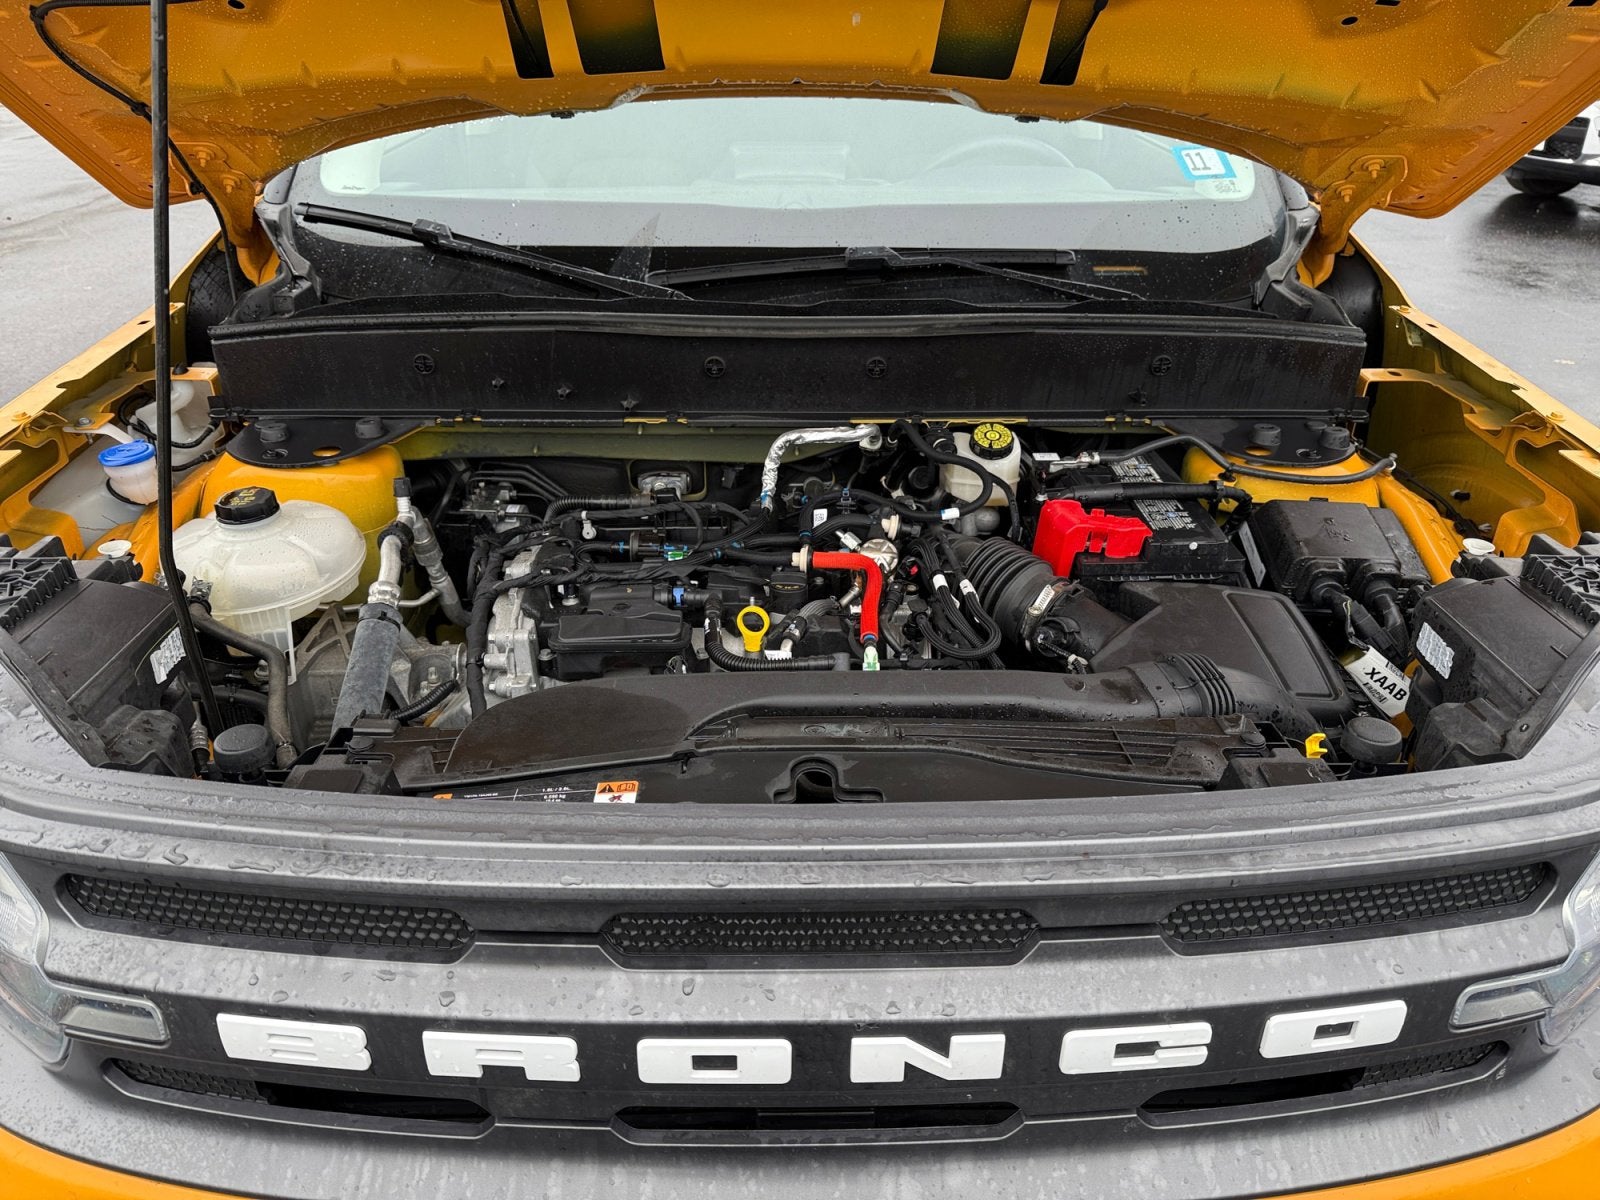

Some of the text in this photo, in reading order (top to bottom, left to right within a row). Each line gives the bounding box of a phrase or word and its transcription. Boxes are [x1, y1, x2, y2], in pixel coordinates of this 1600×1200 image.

[1184, 152, 1212, 171] 11
[1364, 667, 1407, 701] XAAB
[216, 999, 1408, 1084] BRONCO
